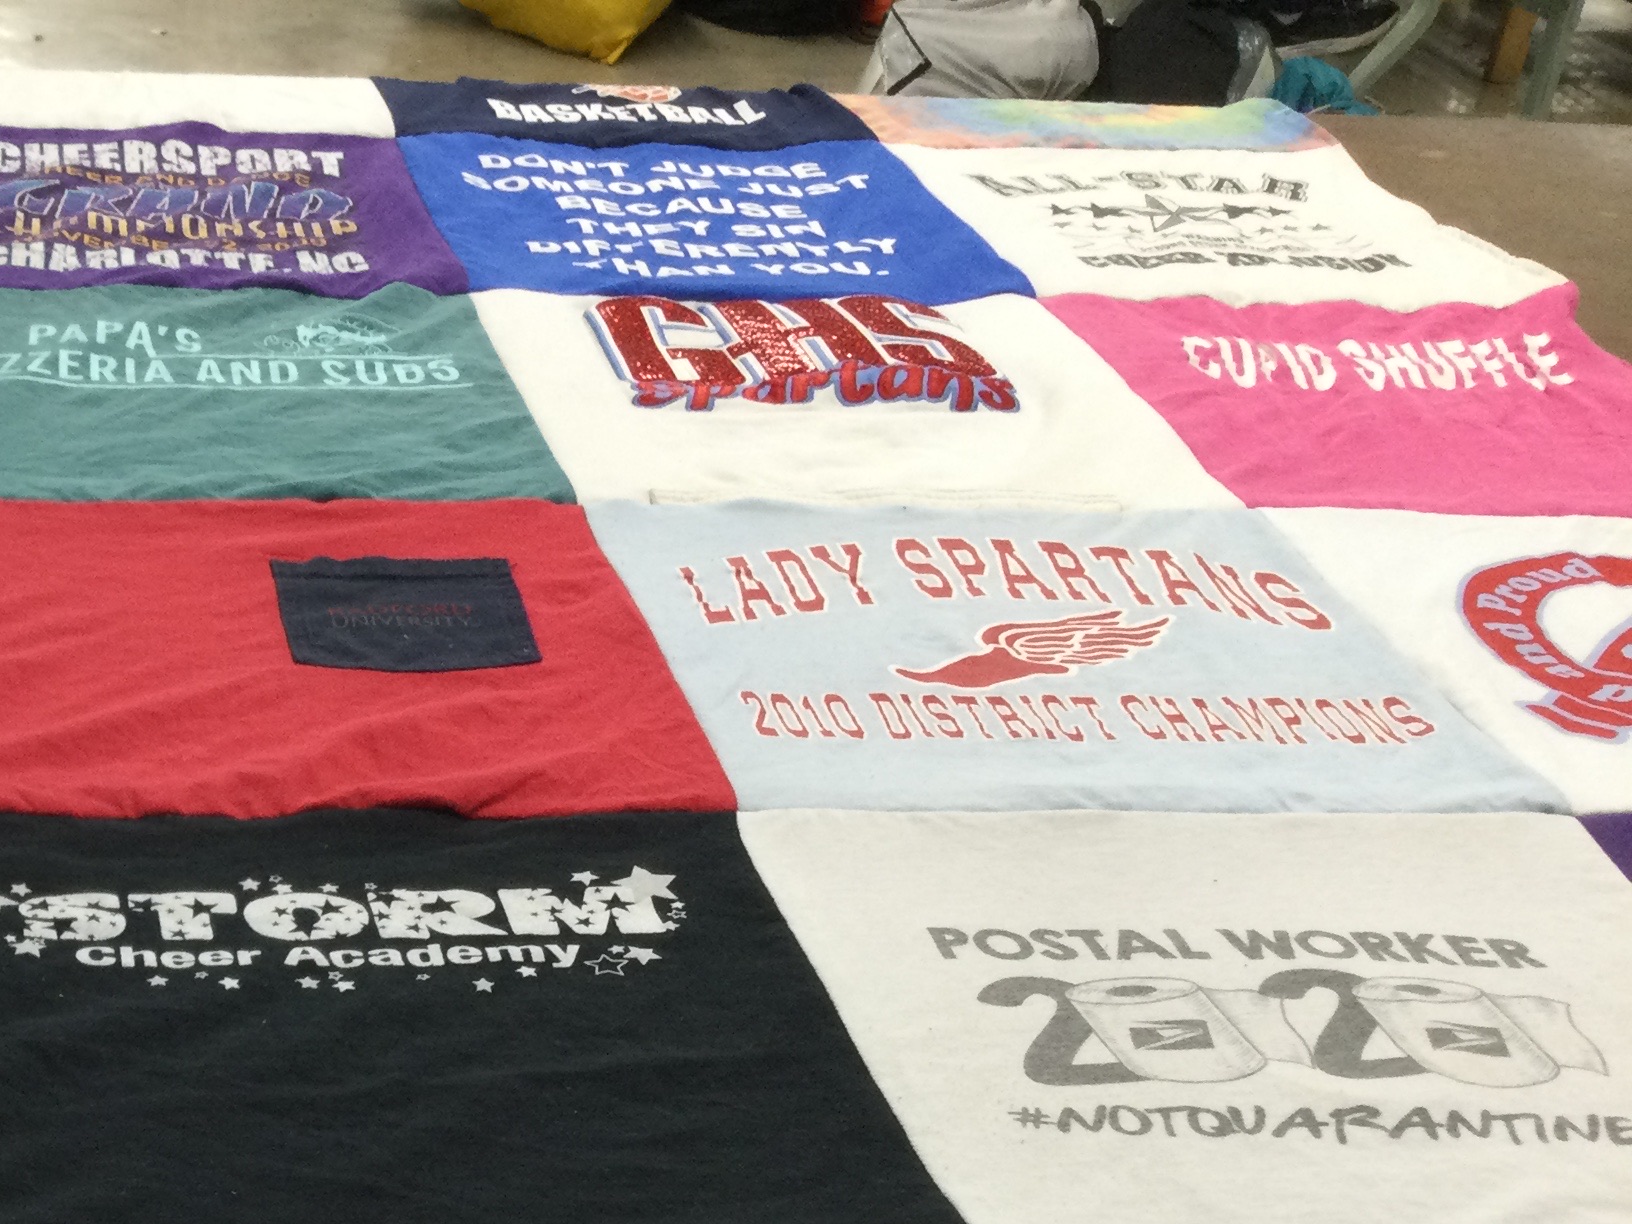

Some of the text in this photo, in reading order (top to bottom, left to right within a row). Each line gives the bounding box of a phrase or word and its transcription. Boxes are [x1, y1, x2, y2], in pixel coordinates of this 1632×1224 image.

[486, 98, 766, 126] BASKETBALL
[478, 154, 826, 180] DON'T JUDGE
[462, 171, 869, 198] SOMEONE JUST
[965, 170, 1309, 203] ALL-STAR
[555, 195, 807, 219] BECAUSE
[566, 218, 827, 238] THEY SIN
[296, 249, 370, 275] NC
[526, 238, 896, 259] DIFFERENTLY
[573, 257, 889, 278] THAN YOU.
[28, 319, 202, 357] PAPA'S
[584, 295, 1002, 387] CHS
[196, 359, 299, 385] AND
[1181, 331, 1576, 392] CUPID SHUFFLE
[632, 360, 1021, 412] Spartans
[678, 536, 1335, 632] LADY SPARTANS
[738, 689, 1438, 747] 2010 DISTRICT CHAMPIONS
[16, 885, 670, 941] STORM
[74, 942, 583, 972] Cheer Academy
[925, 926, 1550, 970] POSTAL WORKER
